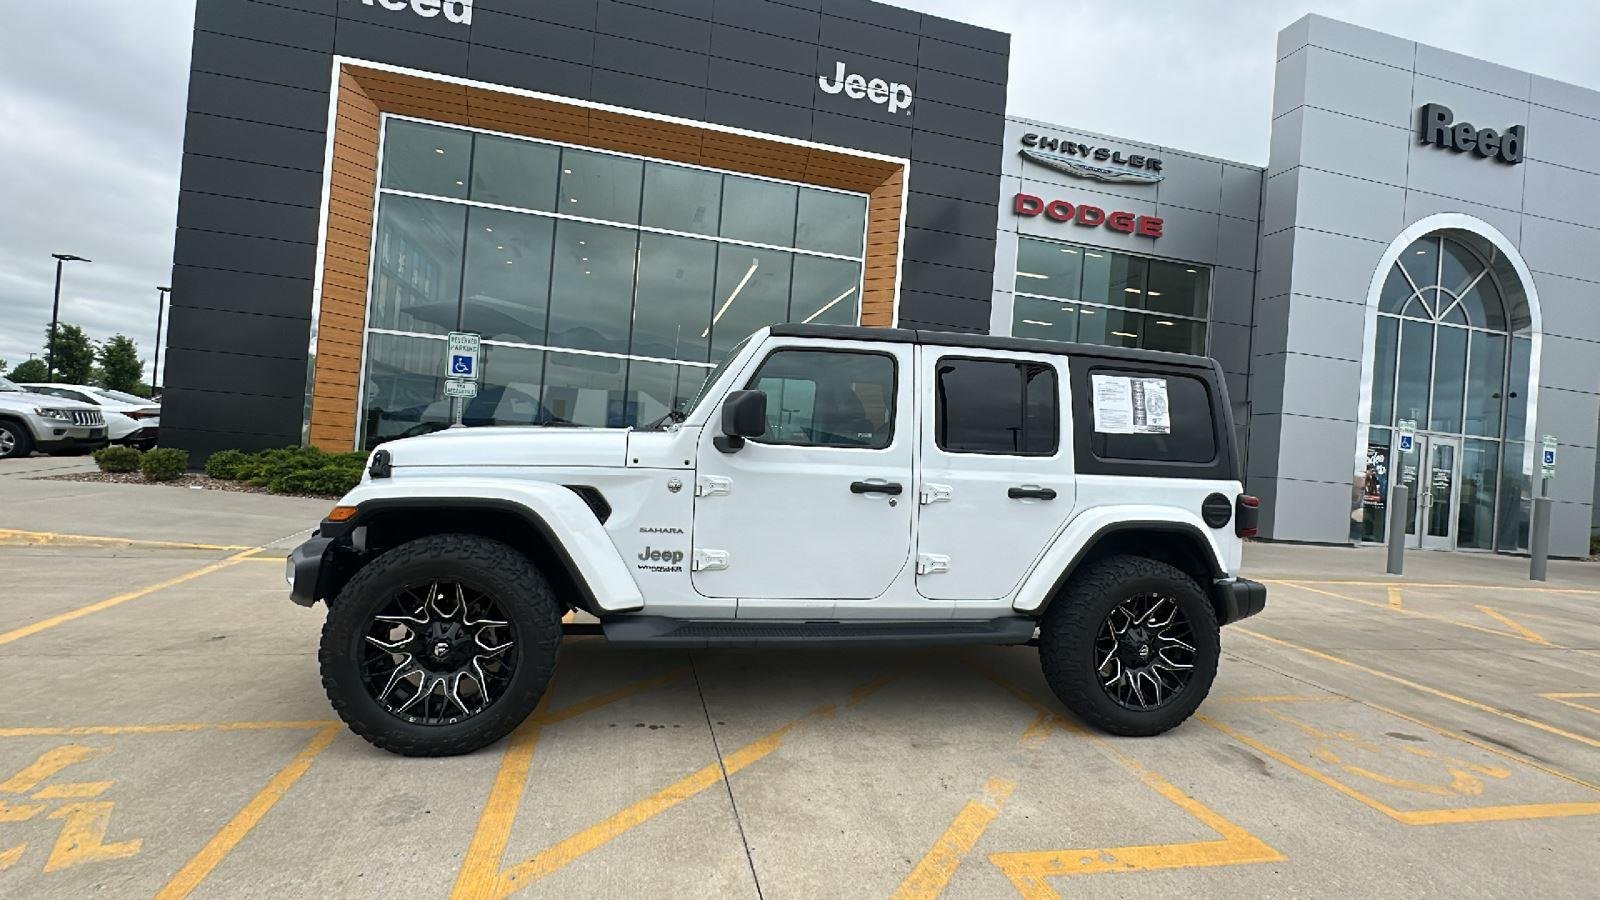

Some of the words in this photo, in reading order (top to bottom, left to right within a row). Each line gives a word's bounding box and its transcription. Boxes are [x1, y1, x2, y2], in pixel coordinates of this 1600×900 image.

[818, 61, 913, 113] Jeep
[1020, 132, 1164, 171] CHRYSLER
[1419, 102, 1526, 164] Reed
[1014, 193, 1164, 238] DODGE
[638, 546, 684, 565] Jeep
